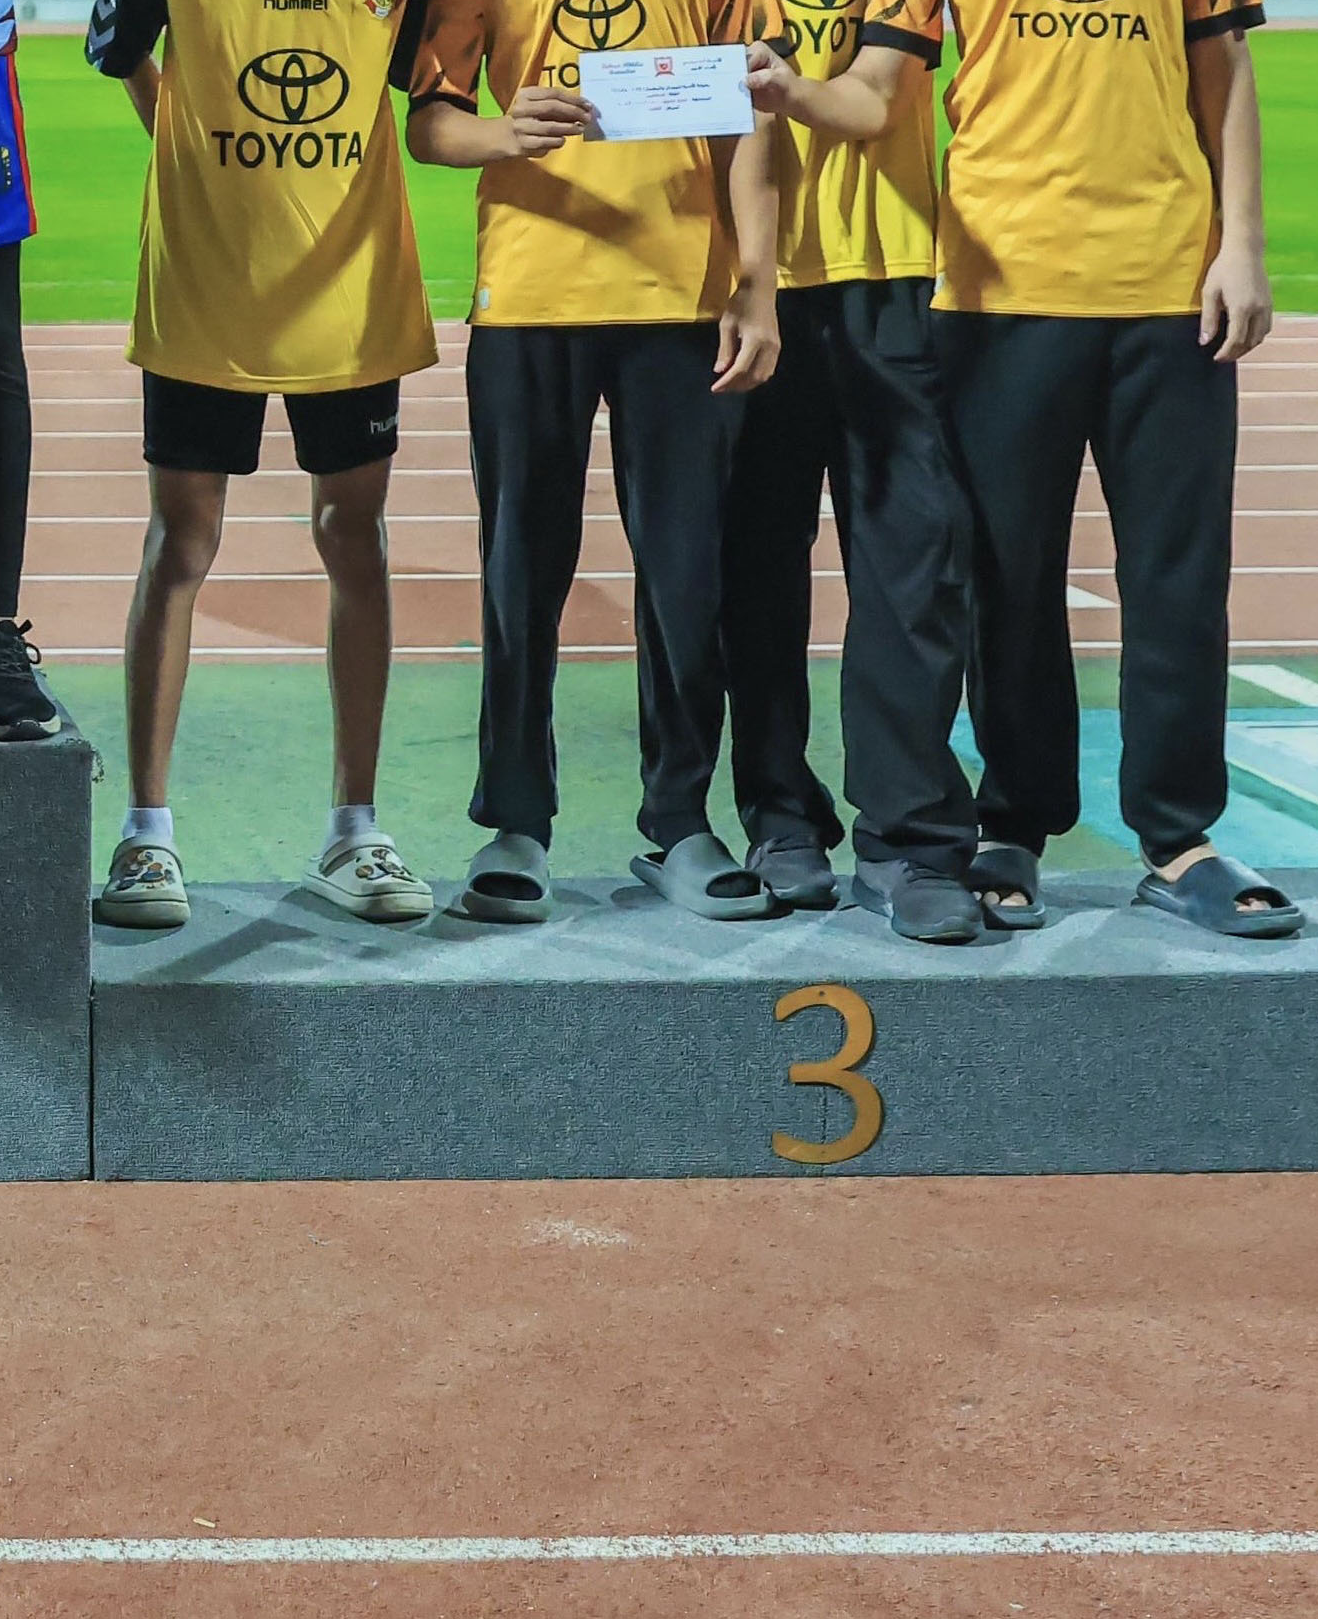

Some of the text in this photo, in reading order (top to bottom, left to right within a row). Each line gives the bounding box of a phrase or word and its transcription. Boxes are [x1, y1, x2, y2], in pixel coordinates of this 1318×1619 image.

[1009, 11, 1151, 41] TOYOTA
[211, 131, 363, 169] TOYOTA
[771, 983, 883, 1165] 3
